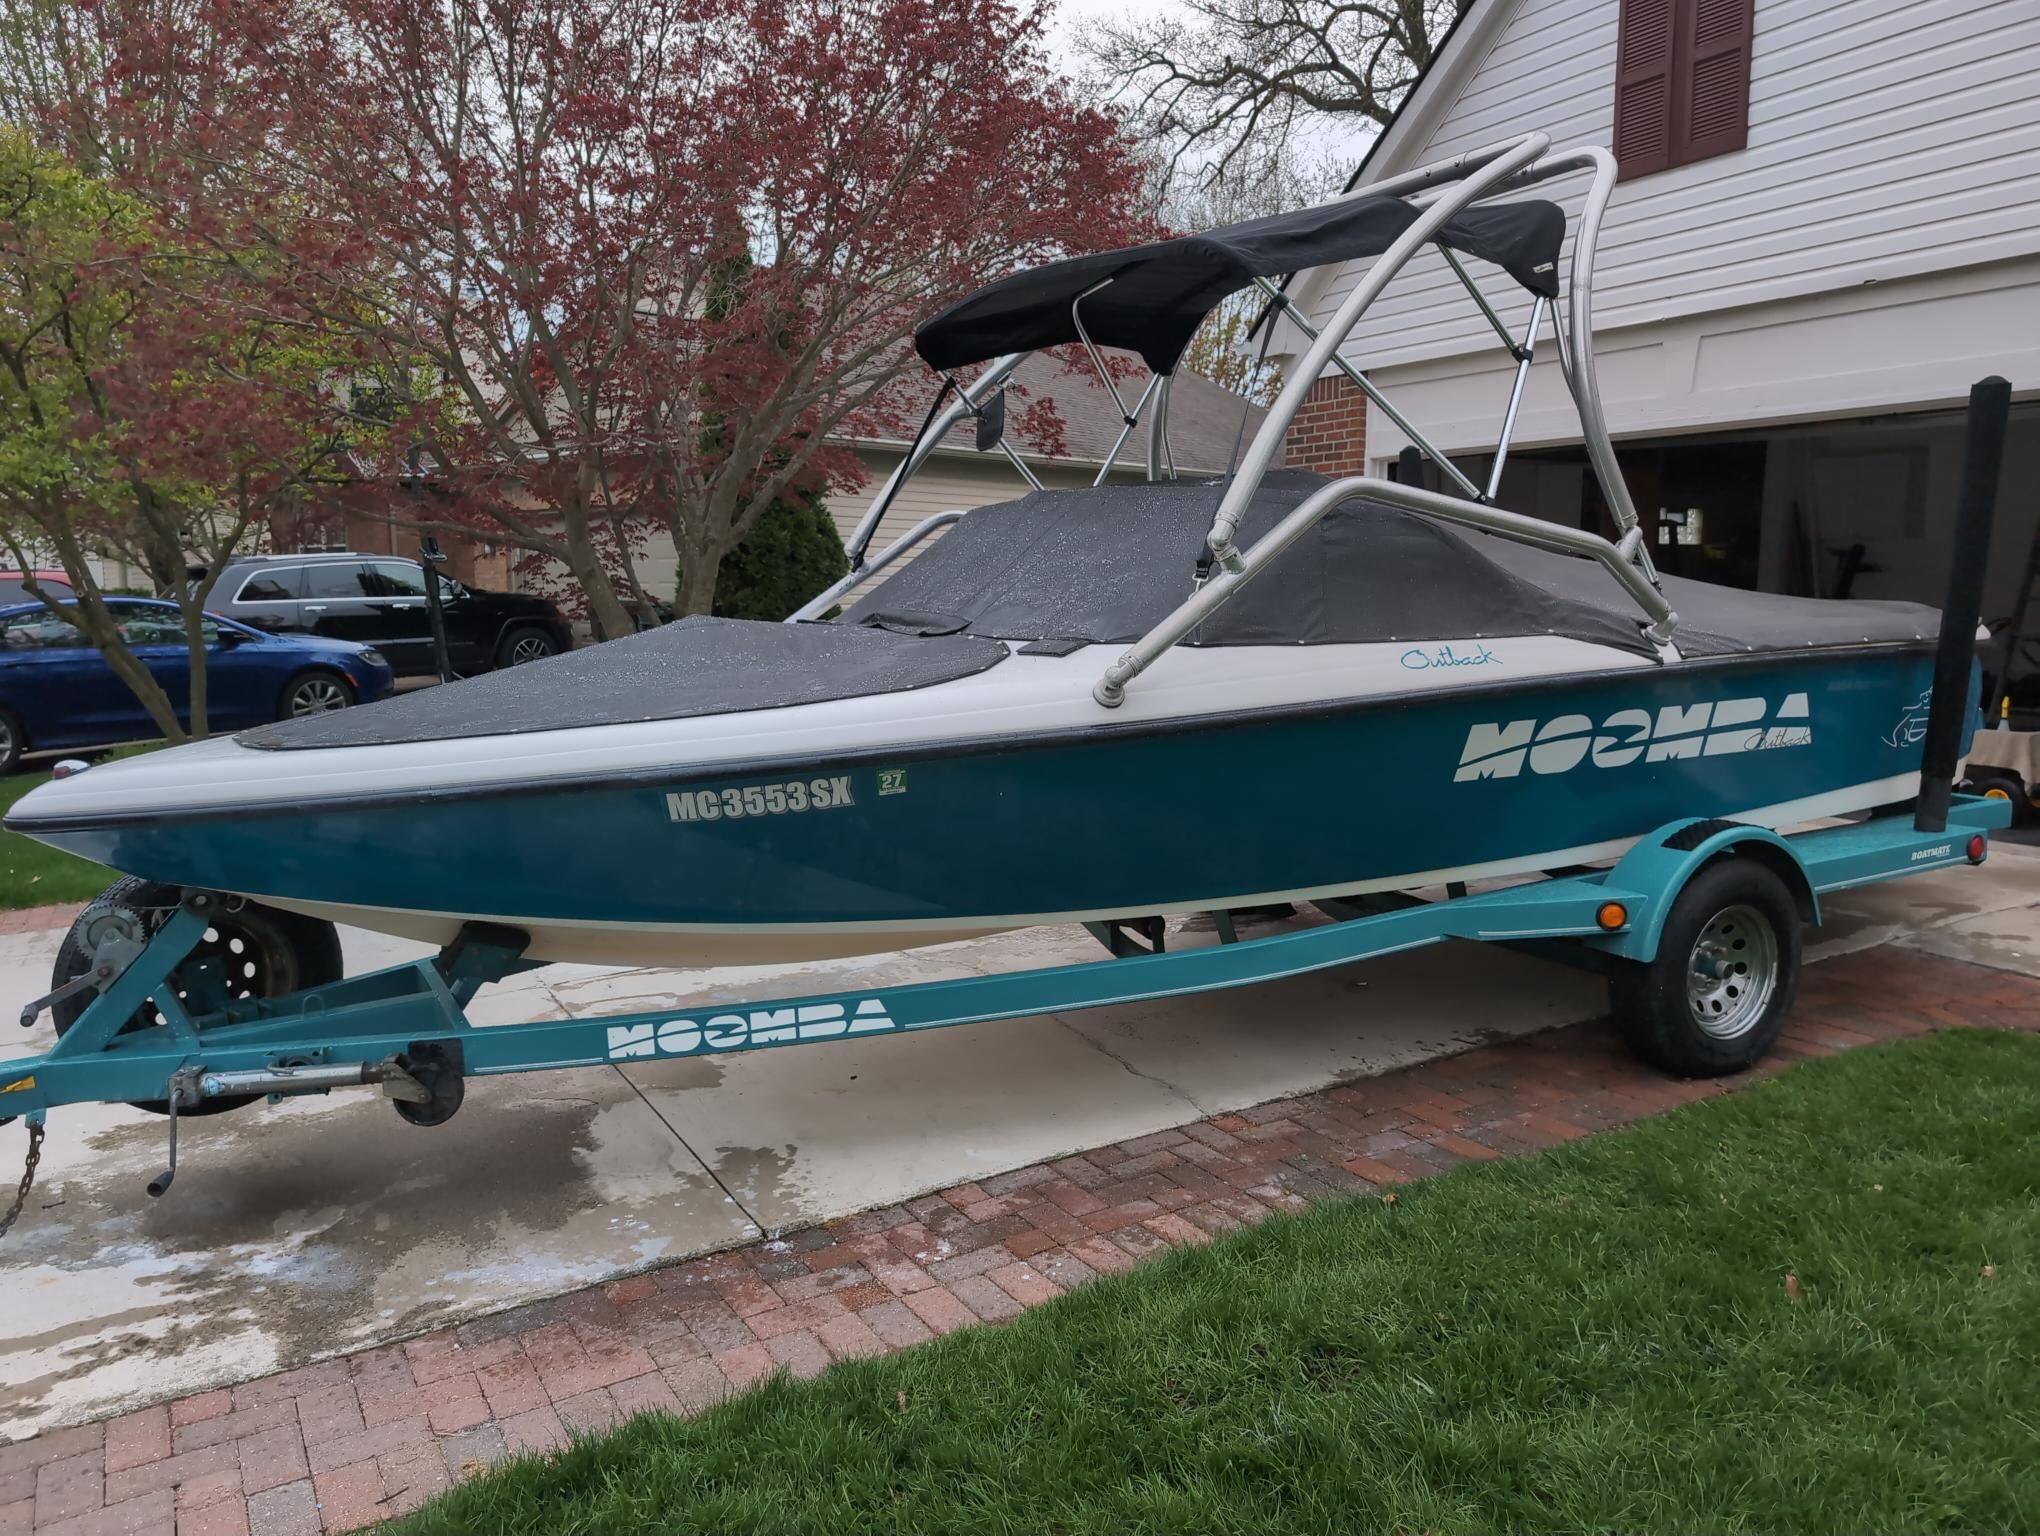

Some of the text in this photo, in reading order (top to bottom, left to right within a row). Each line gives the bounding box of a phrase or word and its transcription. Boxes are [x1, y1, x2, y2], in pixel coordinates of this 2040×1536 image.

[1400, 644, 1504, 670] Outback
[1453, 692, 1811, 782] MOOMBA
[666, 776, 855, 822] MC3553SX
[882, 774, 902, 789] 27
[606, 999, 896, 1059] MOOMBA
